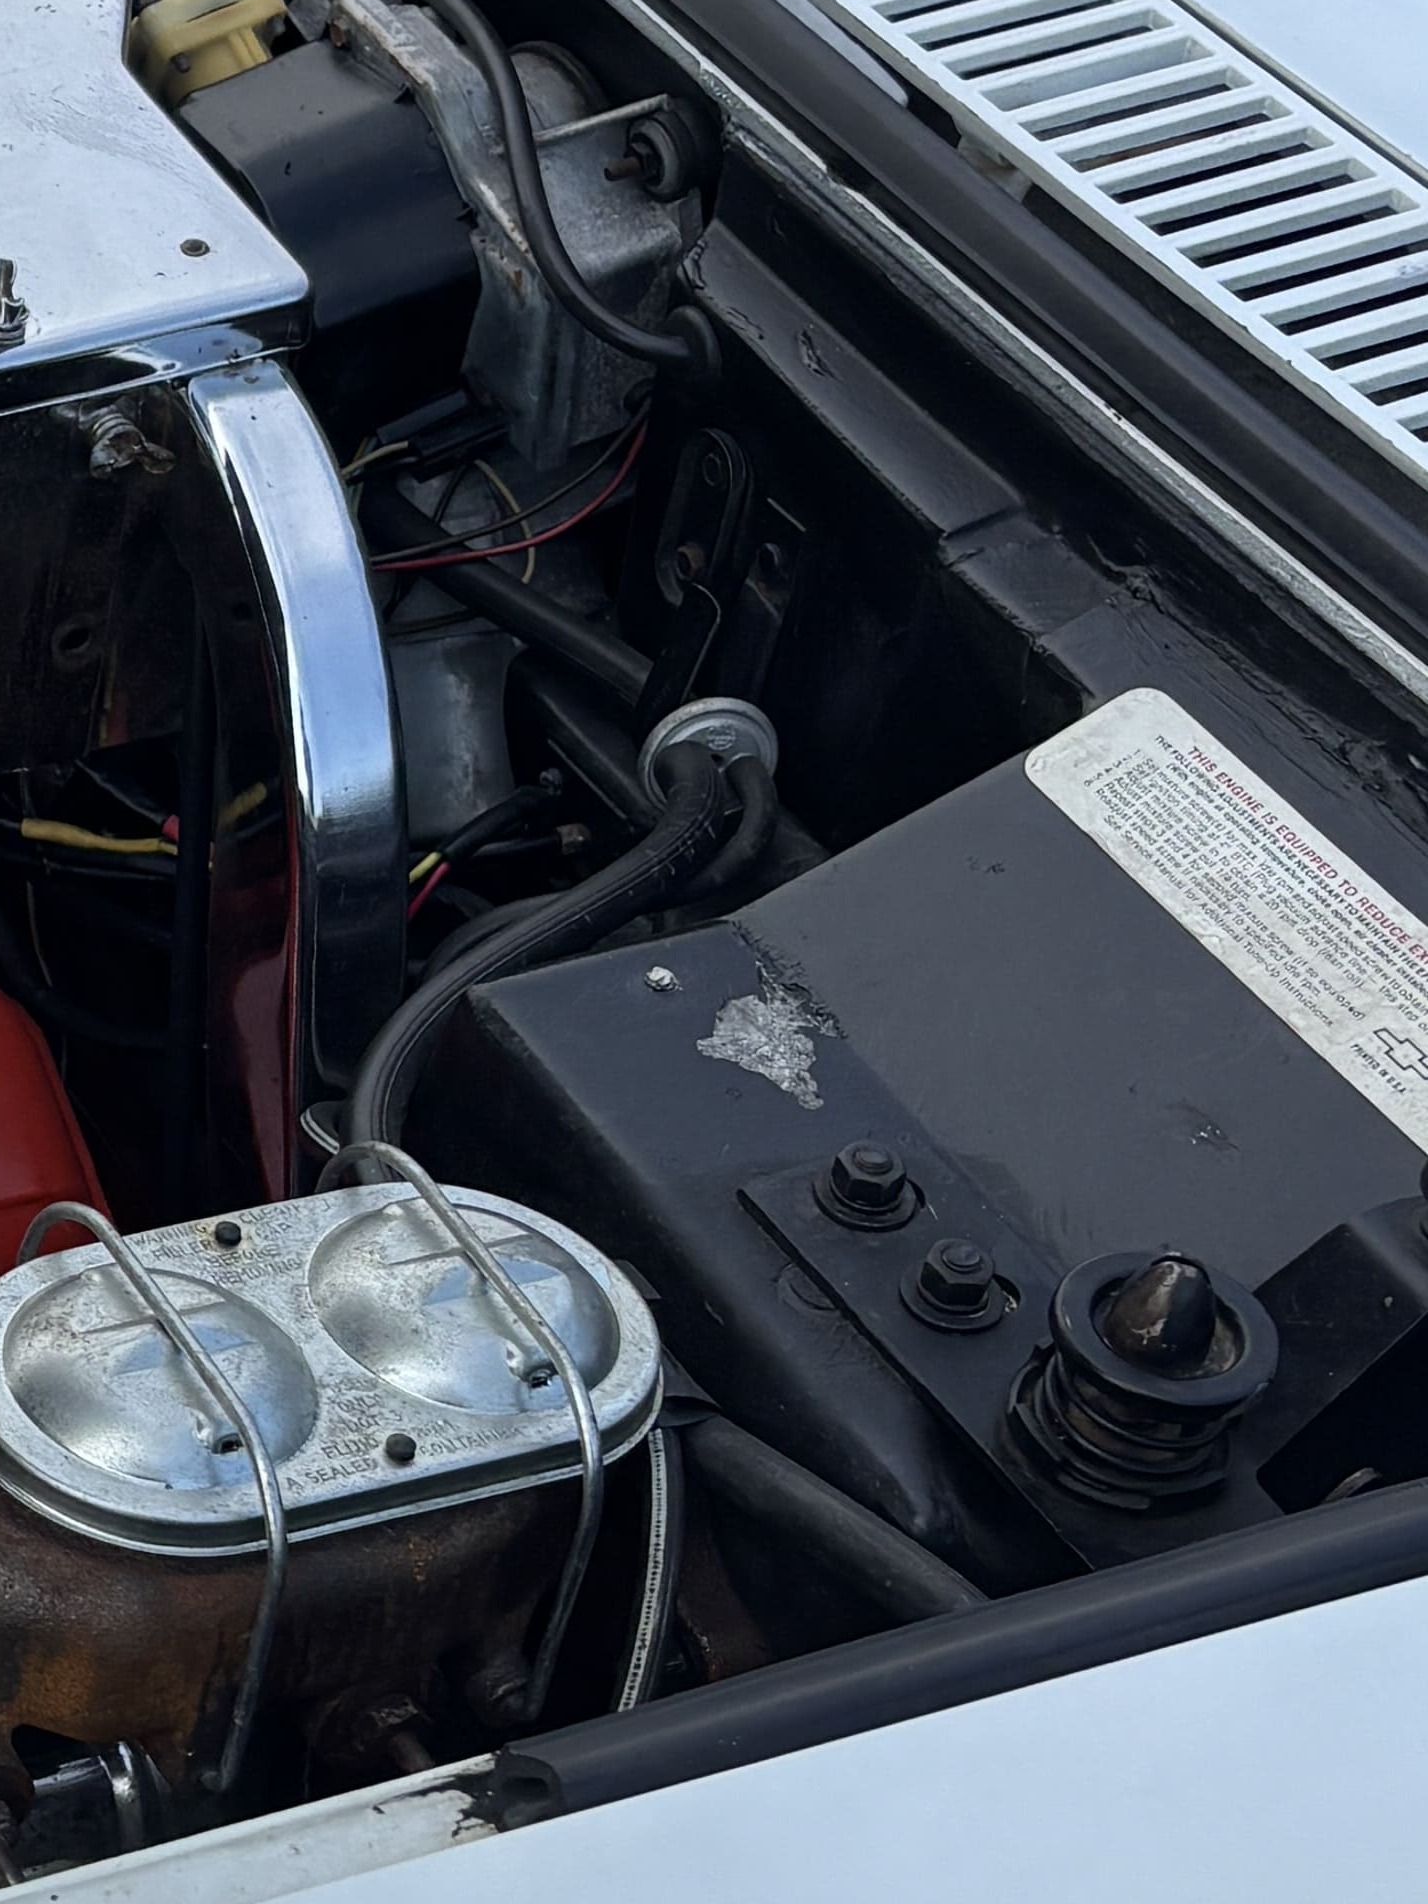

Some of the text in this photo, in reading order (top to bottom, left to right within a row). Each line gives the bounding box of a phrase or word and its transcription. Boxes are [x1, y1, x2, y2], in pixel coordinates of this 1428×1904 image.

[1169, 746, 1220, 794] FOLLOWING
[1216, 787, 1280, 847] ADJUSTMENTS
[1276, 841, 1298, 862] ARE
[1293, 855, 1347, 907] NECESSARY
[1355, 912, 1401, 955] MAINTAIN
[1397, 949, 1419, 971] THE
[1186, 744, 1218, 774] THIS
[1214, 767, 1264, 816] ENGINE
[1274, 821, 1339, 883] EQUIPPED
[1354, 893, 1411, 947] REDUCE
